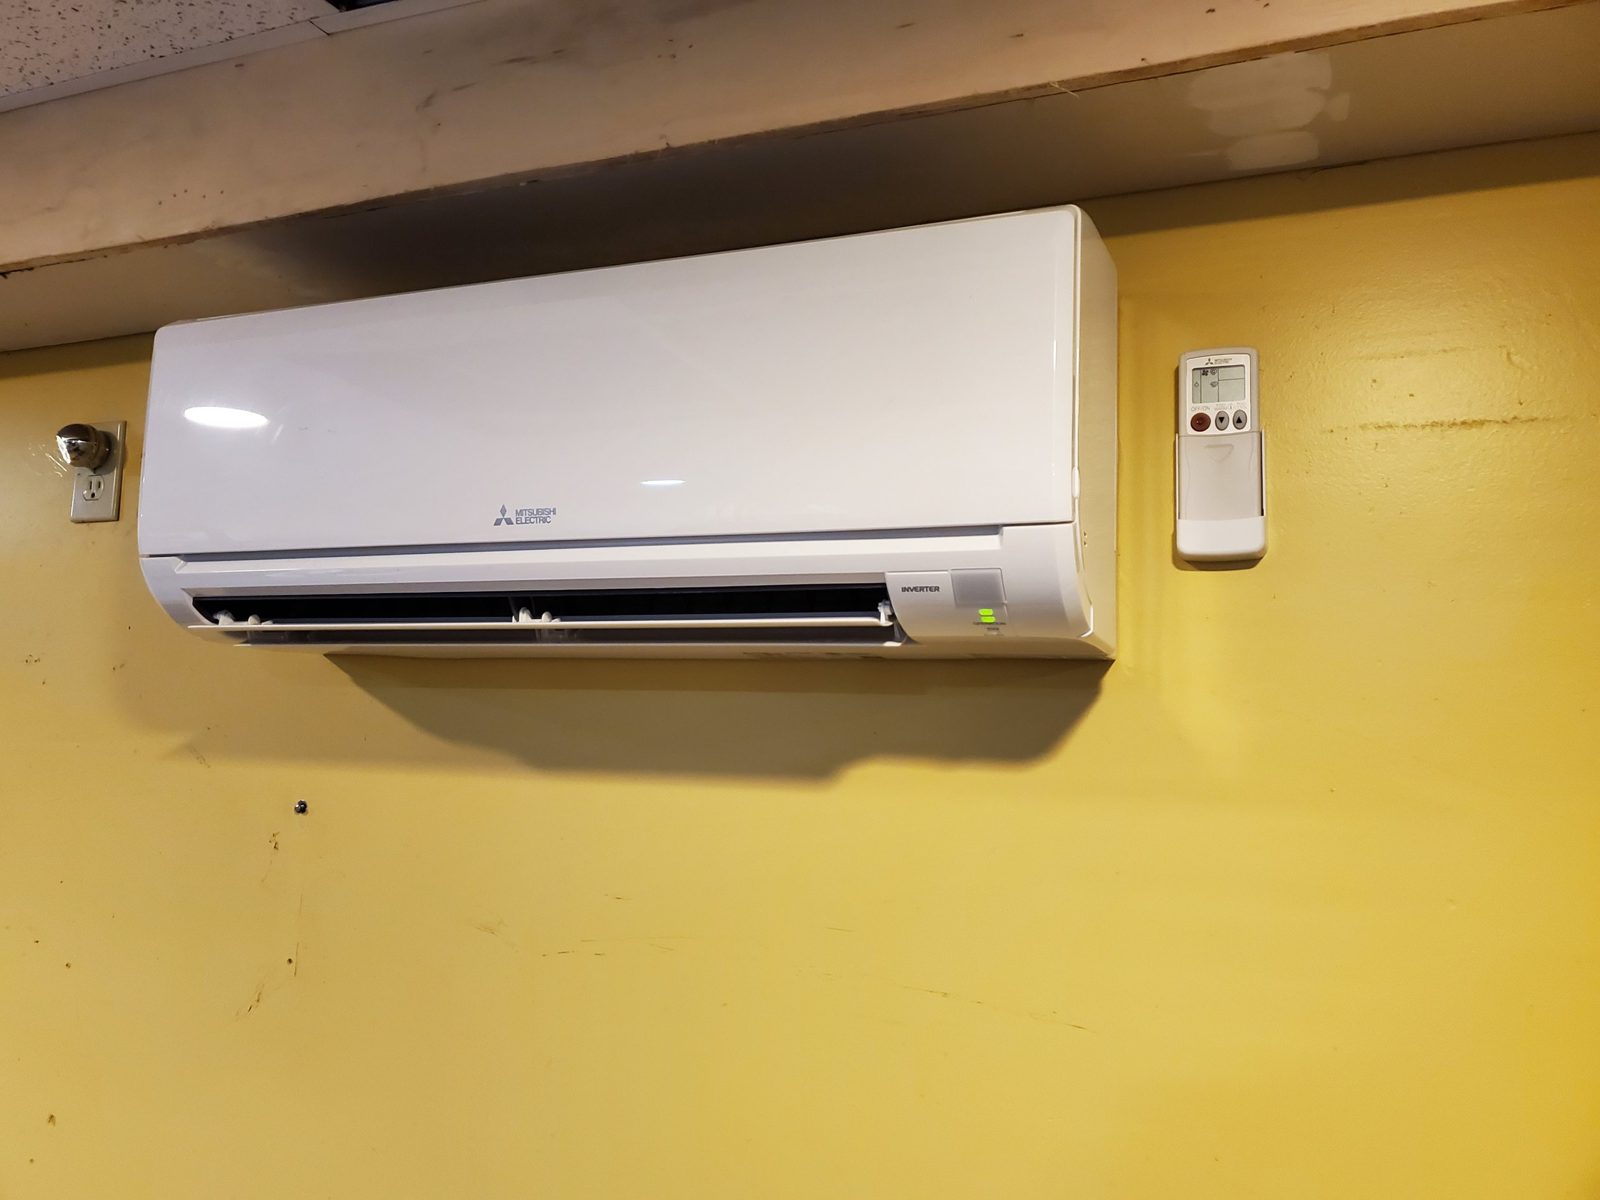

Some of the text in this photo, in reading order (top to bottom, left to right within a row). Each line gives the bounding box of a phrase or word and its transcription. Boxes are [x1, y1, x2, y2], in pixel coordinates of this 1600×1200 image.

[515, 508, 557, 517] MITSUBISHI
[515, 516, 552, 525] ELECTRIC
[901, 585, 940, 593] INVERTER
